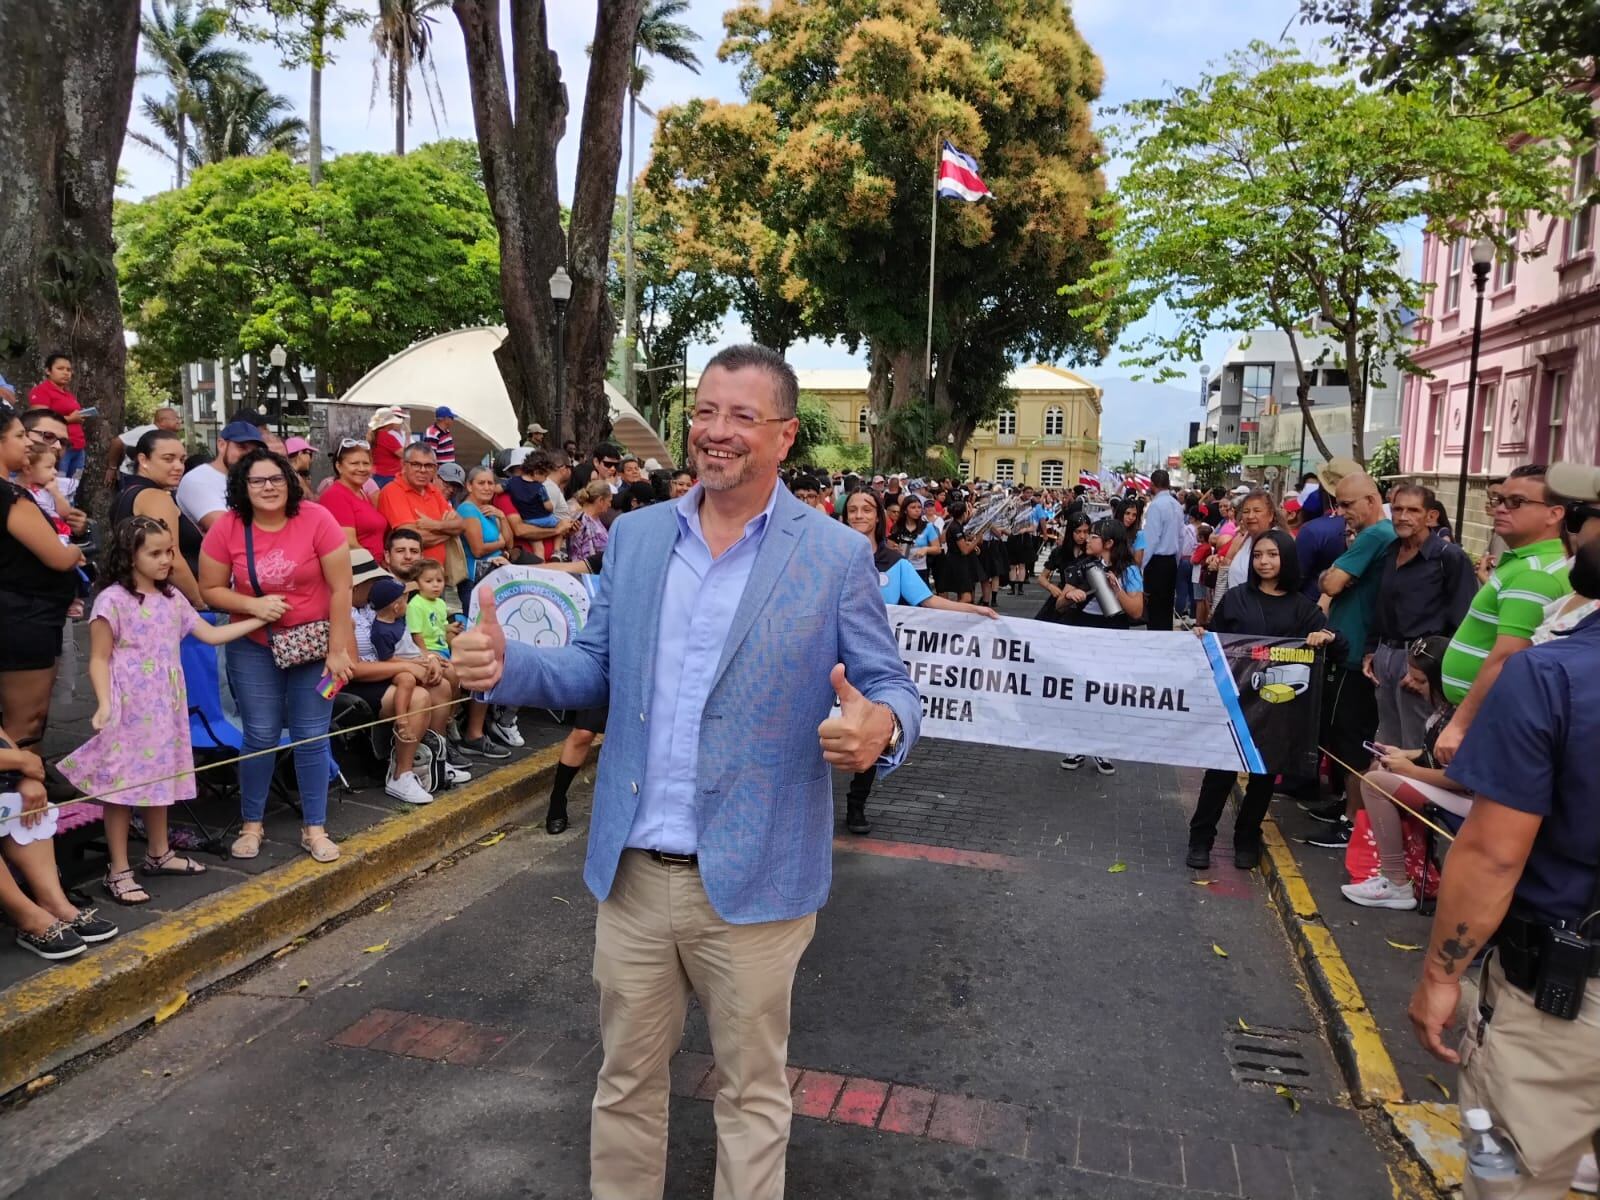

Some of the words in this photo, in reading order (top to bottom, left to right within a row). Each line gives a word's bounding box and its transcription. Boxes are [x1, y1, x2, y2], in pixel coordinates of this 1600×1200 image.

[895, 622, 981, 658] ÍTMICA
[991, 638, 1035, 664] DEL
[1269, 646, 1315, 664] SEGURIDAD
[919, 694, 973, 722] CHEA
[1042, 675, 1074, 700] DE
[1085, 680, 1190, 712] PURRAL
